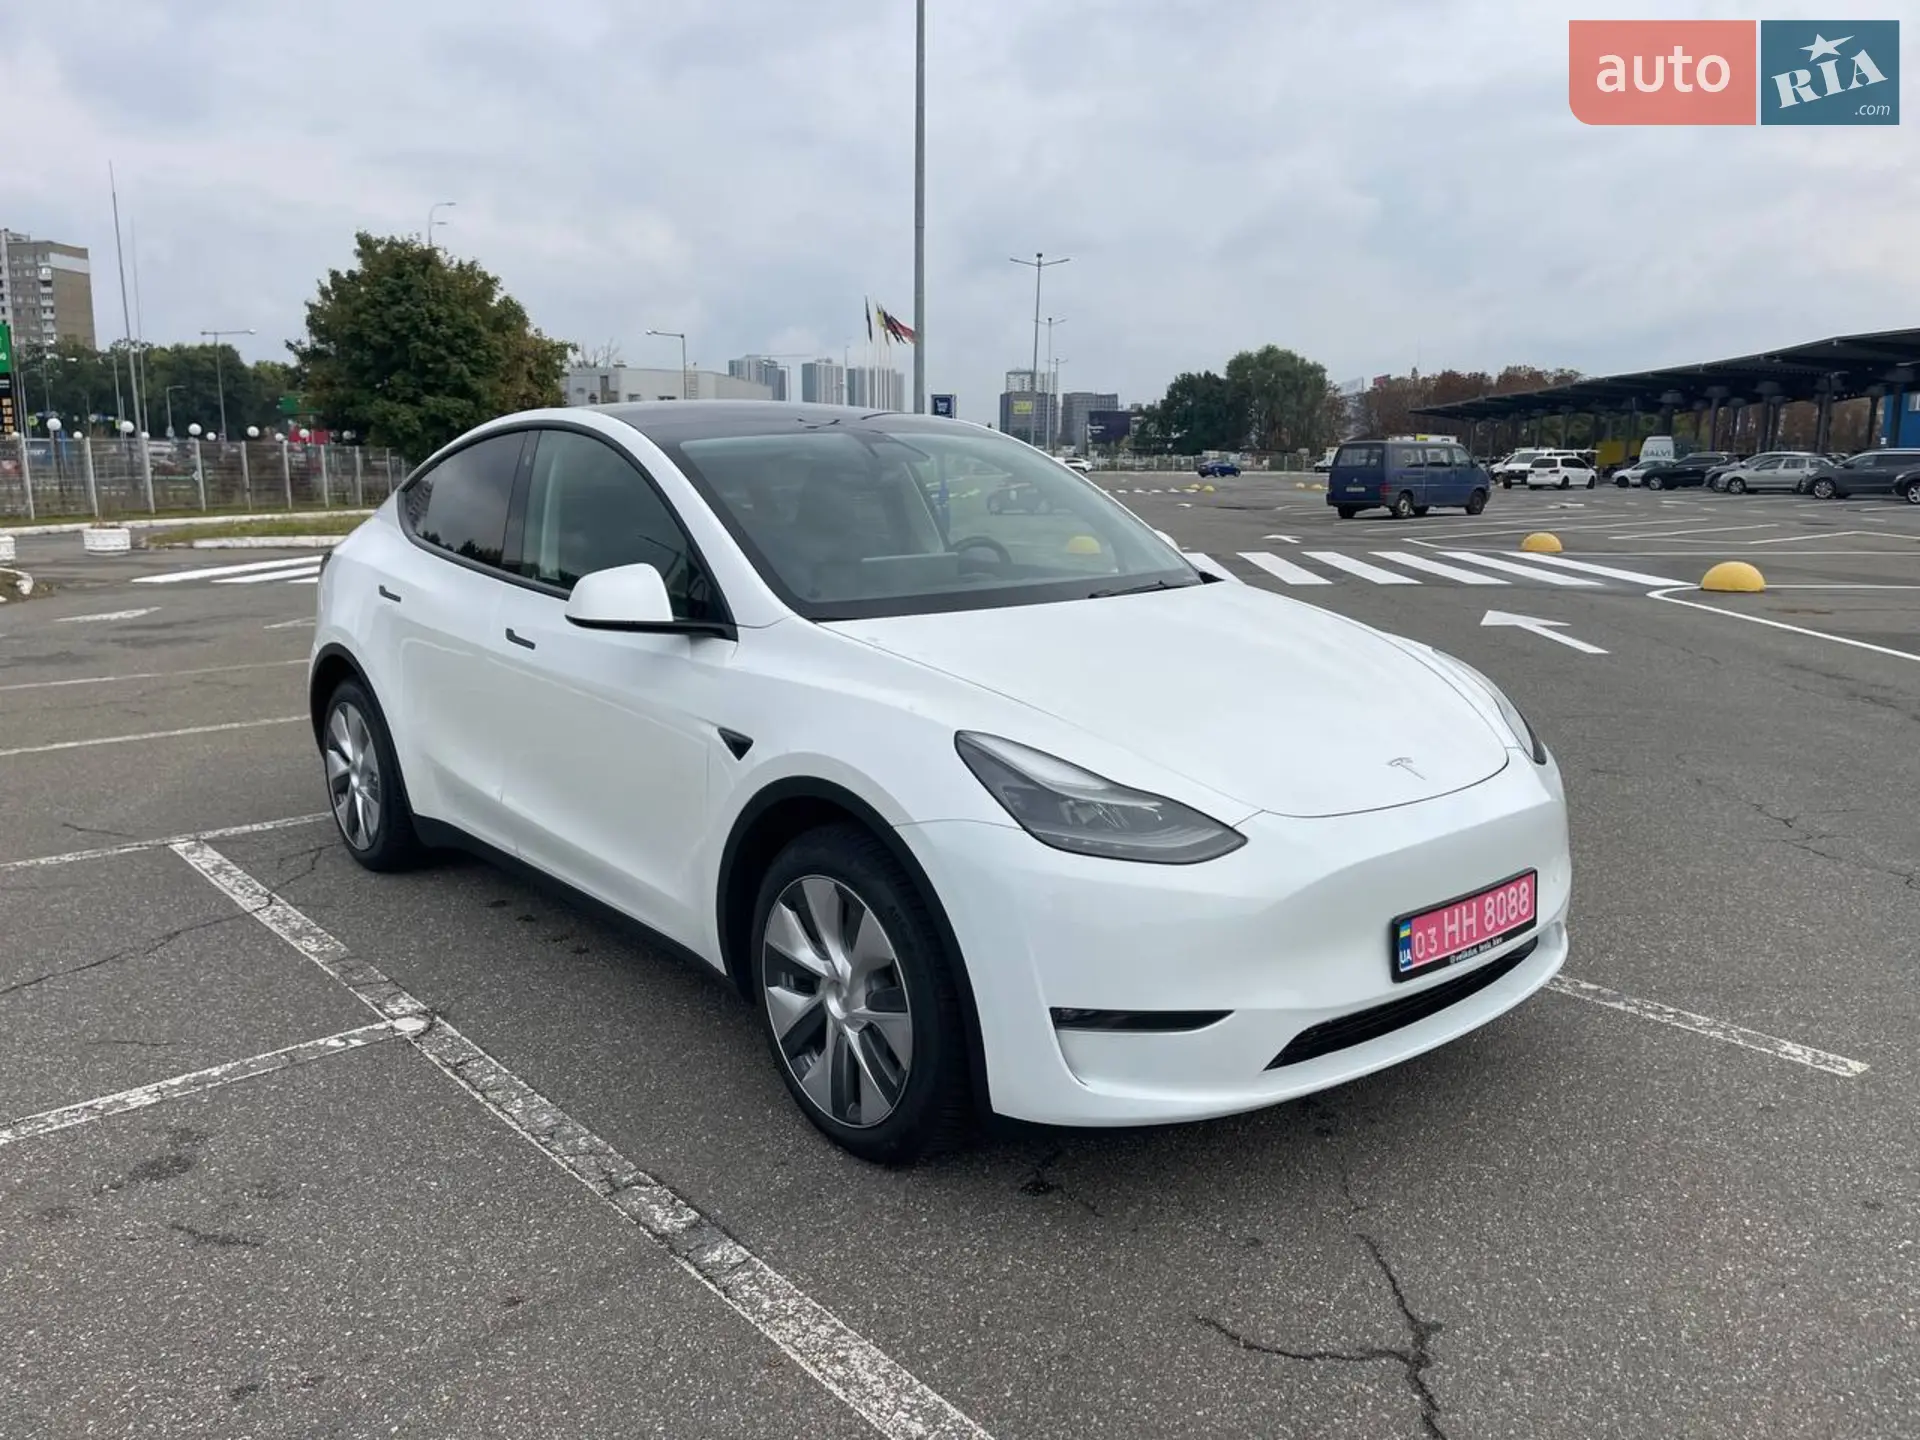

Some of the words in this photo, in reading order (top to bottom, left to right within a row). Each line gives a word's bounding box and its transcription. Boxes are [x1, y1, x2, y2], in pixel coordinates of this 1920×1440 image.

[1415, 927, 1438, 959] 03
[1444, 902, 1477, 949] HH
[1484, 881, 1530, 932] 8088
[1400, 949, 1412, 964] UA
